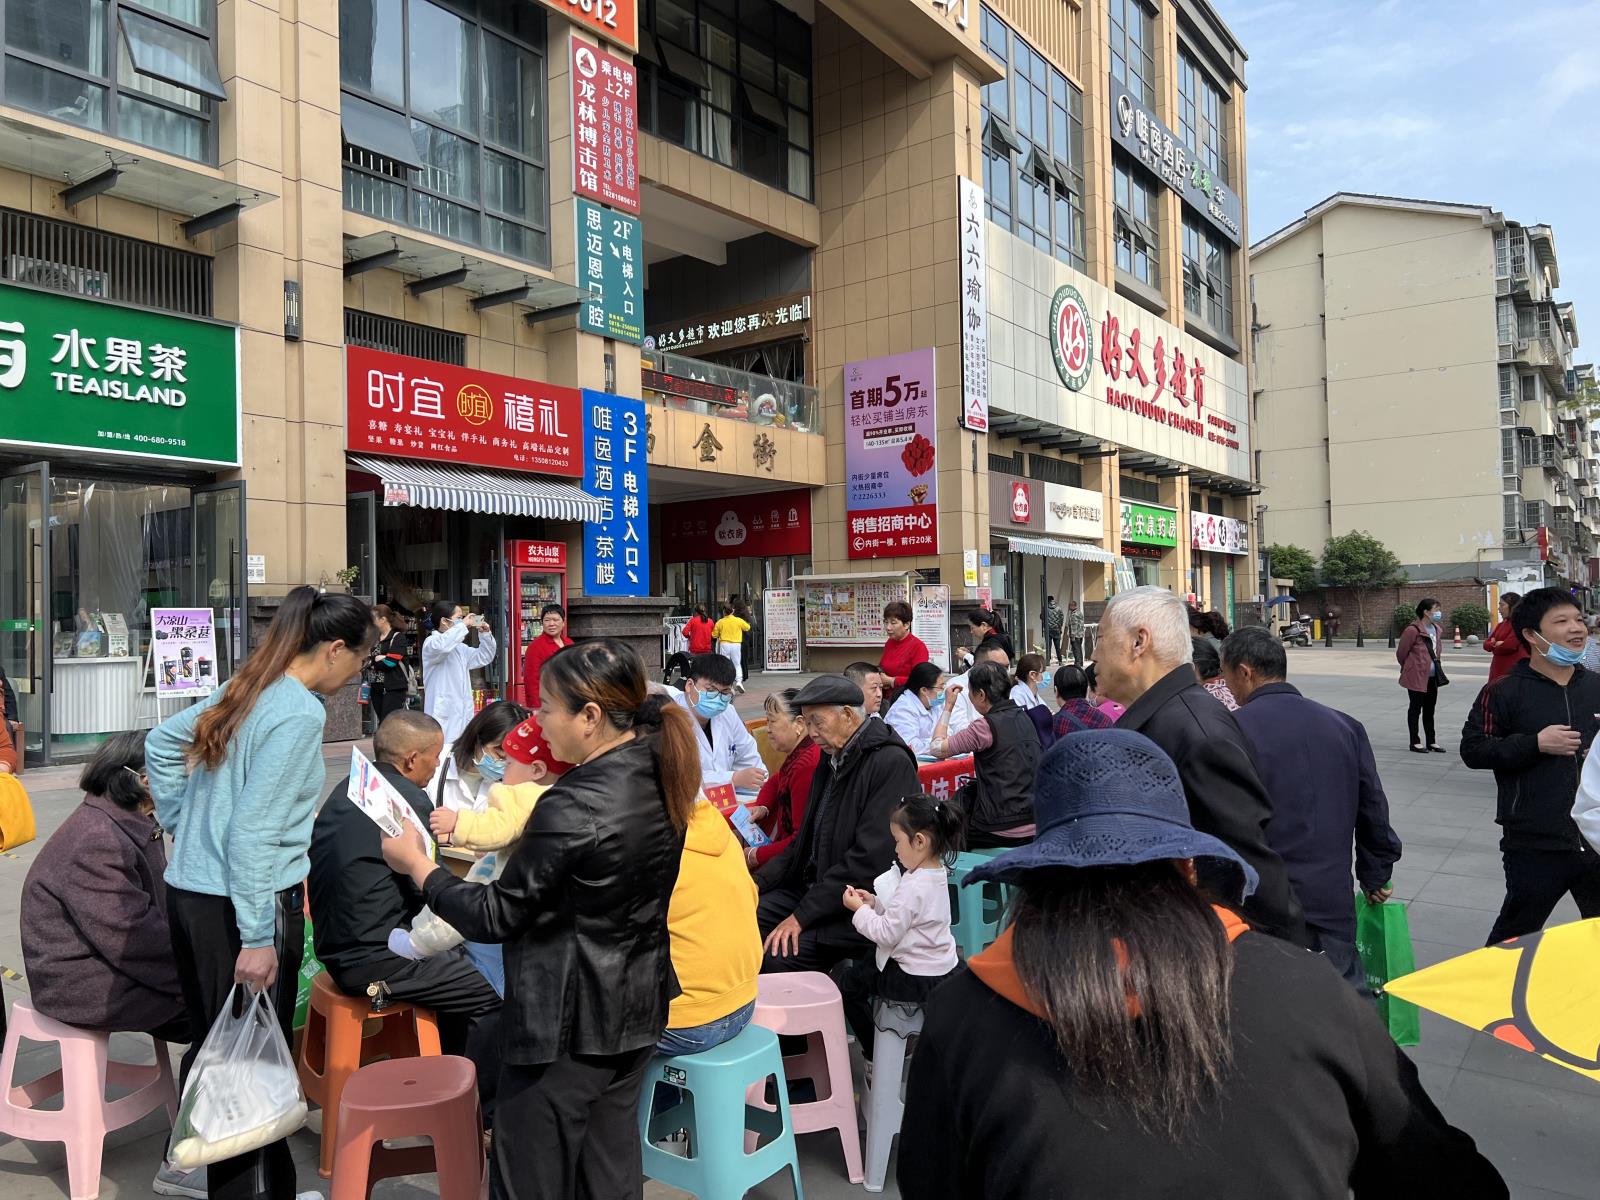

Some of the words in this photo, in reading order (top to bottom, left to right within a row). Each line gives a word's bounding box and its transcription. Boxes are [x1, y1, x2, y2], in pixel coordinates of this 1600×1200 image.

[601, 60, 633, 87] 乘电梯
[604, 80, 631, 101] 上2F
[576, 79, 599, 194] 龙林搏击馆
[612, 220, 632, 240] 2F
[586, 207, 604, 329] 思迈恩口腔
[622, 244, 634, 315] 电梯入口
[966, 212, 983, 330] 六六瑜伽
[657, 325, 705, 348] 好又多超市
[707, 303, 804, 340] 欢迎您再次光临
[51, 329, 189, 386] 水果茶
[1101, 310, 1207, 420] 好又多超市
[50, 371, 187, 408] TEAISLAND
[367, 368, 447, 421] 时宜
[502, 391, 569, 438] 禧礼
[850, 375, 928, 410] 首期5万起
[851, 404, 928, 427] 轻松买铺当房东
[1106, 387, 1167, 424] HAOYOUDUO
[1167, 411, 1204, 438] CHAOSHI
[133, 434, 187, 447] 400-680-9518
[367, 419, 388, 432] 喜糖
[393, 422, 422, 437] 寿宴礼
[428, 428, 456, 441] 宝宝礼
[460, 431, 488, 446] 伴手礼
[492, 436, 518, 450] 商务礼
[522, 440, 571, 458] 高端礼品定制
[851, 512, 932, 534] 销售招商中心
[1133, 512, 1178, 541] 安康药房
[528, 545, 560, 557] 农夫山泉
[155, 614, 189, 627] 大凉山
